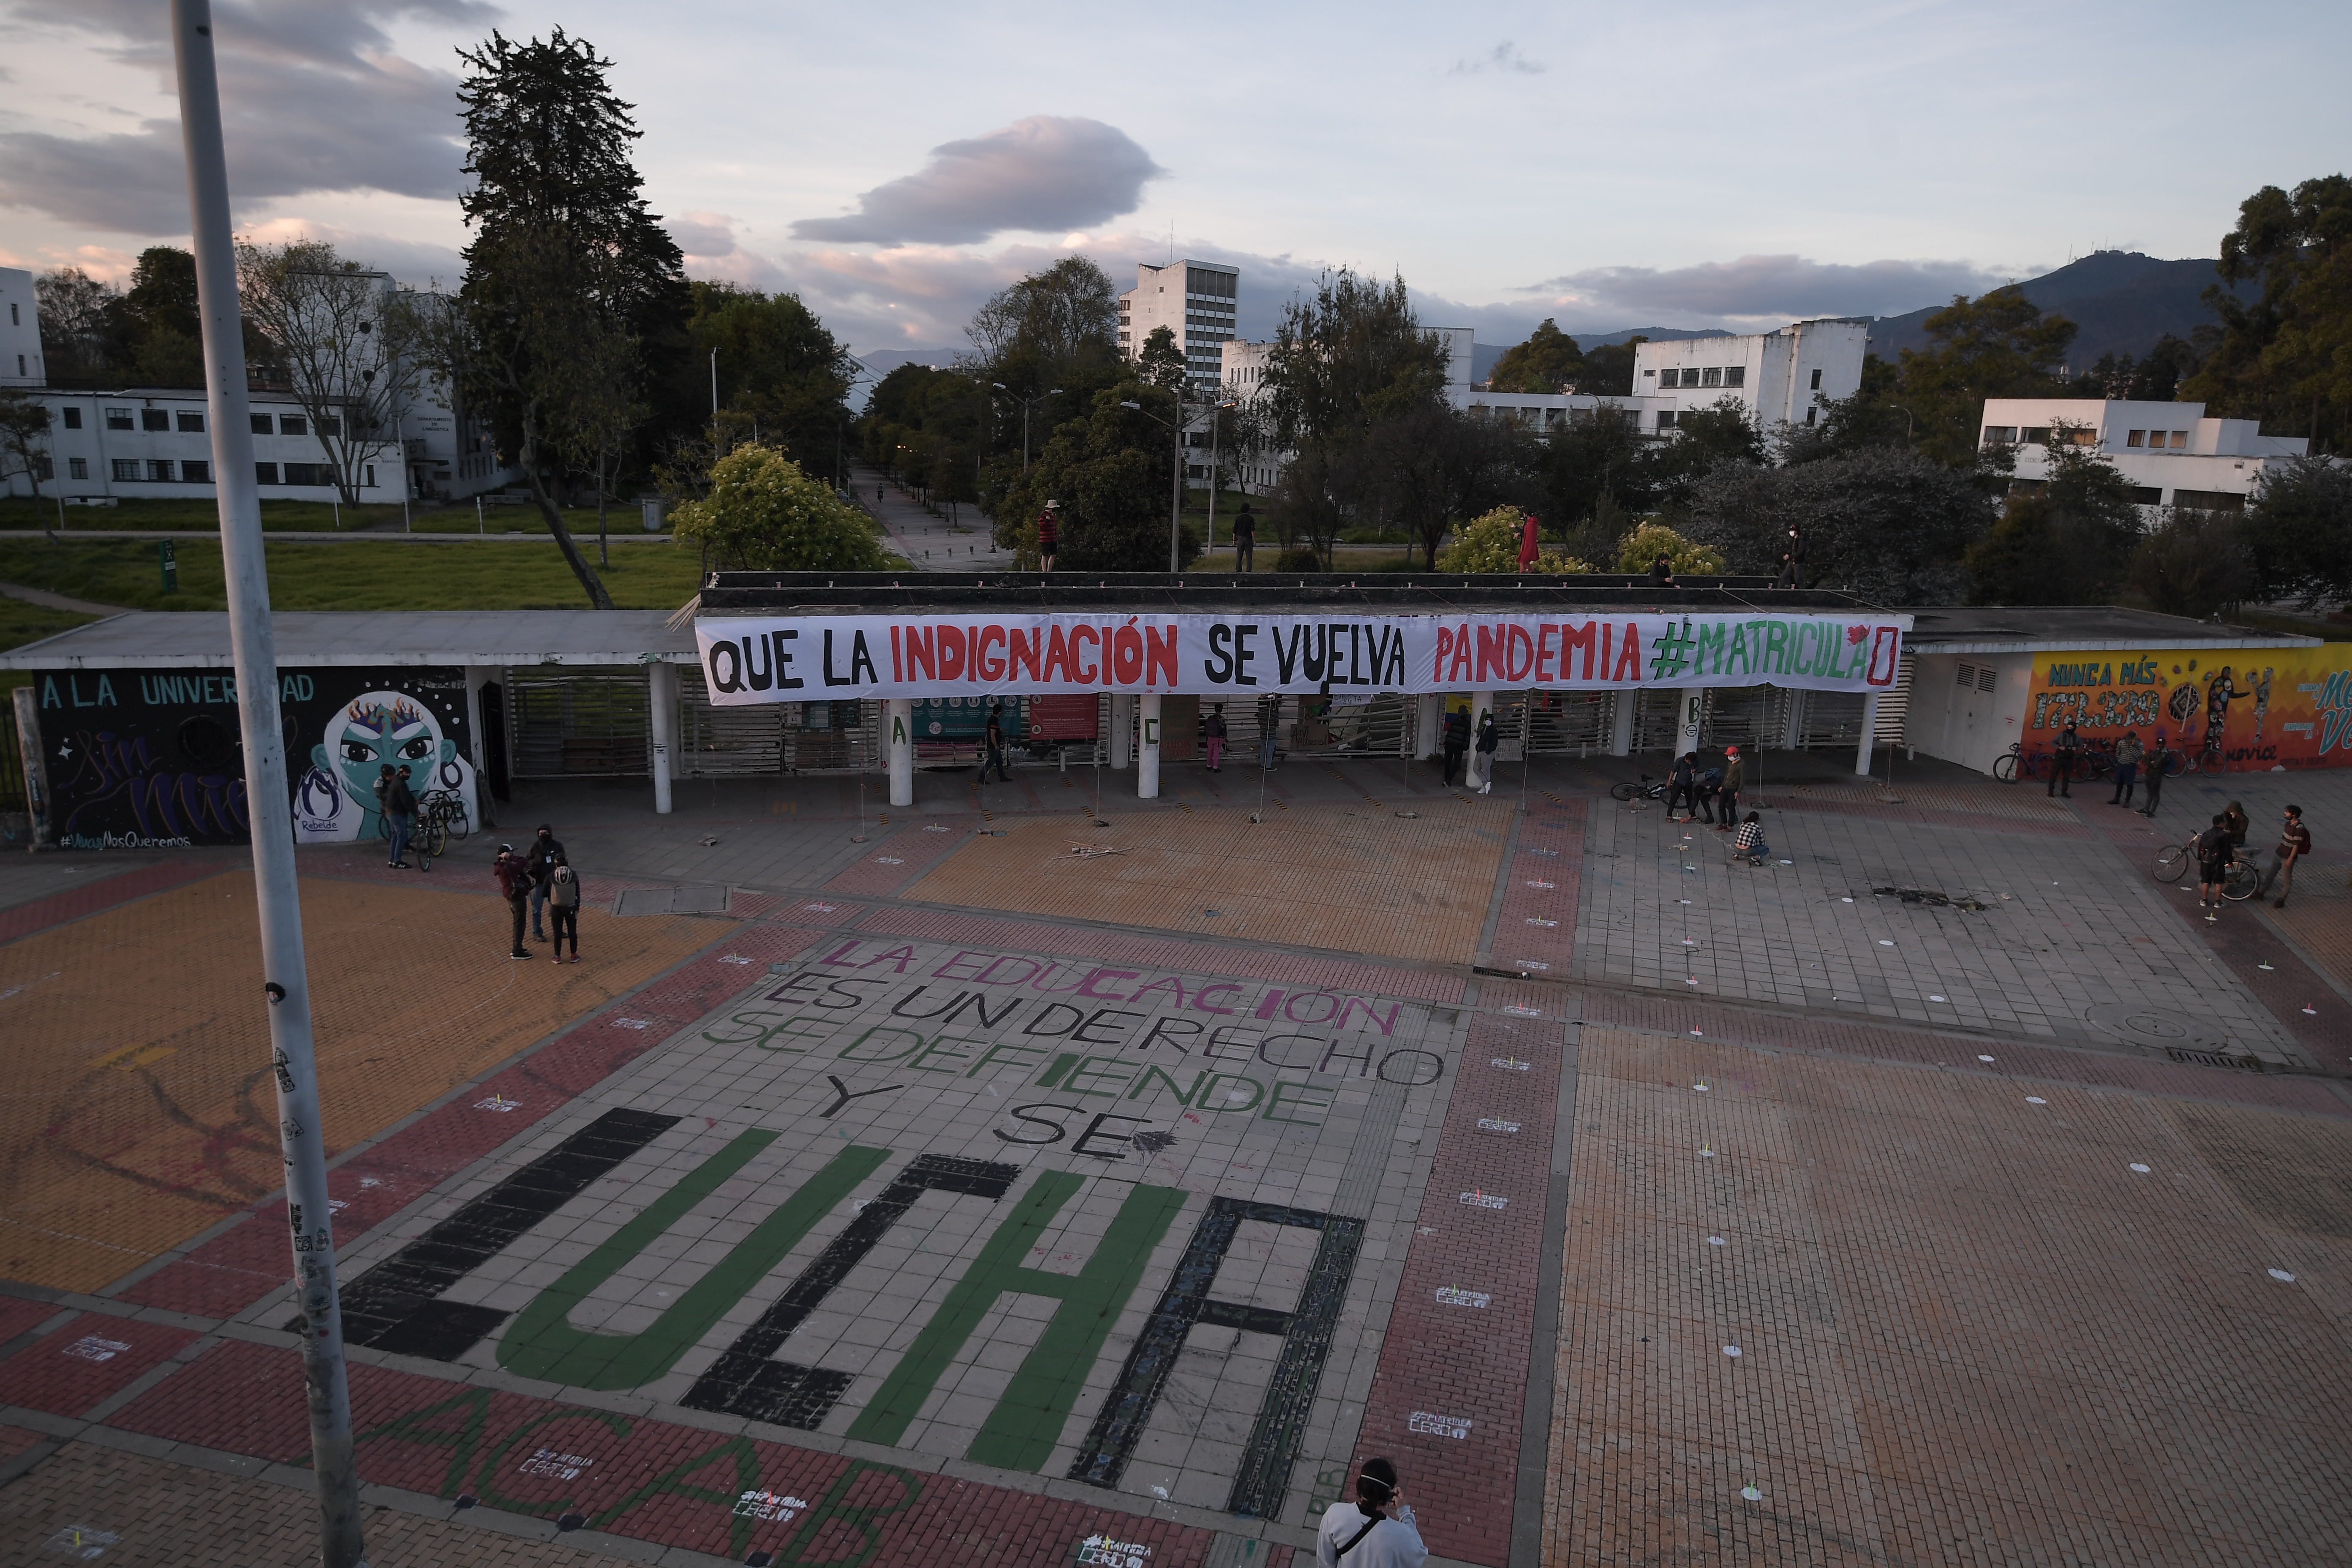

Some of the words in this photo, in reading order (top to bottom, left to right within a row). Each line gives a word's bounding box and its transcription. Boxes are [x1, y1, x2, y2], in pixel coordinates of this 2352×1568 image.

[709, 629, 803, 693] QUE
[823, 629, 879, 687] LA
[890, 616, 1178, 687] INDIGNACIÓN
[1204, 624, 1258, 685] SE
[1272, 623, 1405, 686] VUELVA
[1433, 621, 1641, 683] PANDEMIA
[2048, 663, 2111, 686] NUNCA
[2119, 655, 2157, 685] MÁS
[43, 675, 62, 708] A
[71, 675, 118, 708] LA
[140, 674, 314, 705] UNIVERAD
[1688, 697, 1701, 723] B
[893, 716, 906, 745] A
[1167, 740, 1192, 749] LUCHA
[60, 831, 191, 849] #VivasNosQueremos
[302, 820, 338, 830] Rebelde
[819, 939, 917, 973] LA
[931, 950, 1401, 1036] EDUCACIÓN
[763, 972, 889, 1009] ES
[891, 985, 1024, 1029] UN
[1021, 1002, 1444, 1086] DERECHO
[702, 1011, 847, 1053] SE
[837, 1026, 1334, 1127] DEFIENDE
[819, 1075, 905, 1118] Y
[992, 1103, 1153, 1159] SE
[282, 1106, 1364, 1522] LUCHA
[1409, 1418, 1451, 1437] CERO
